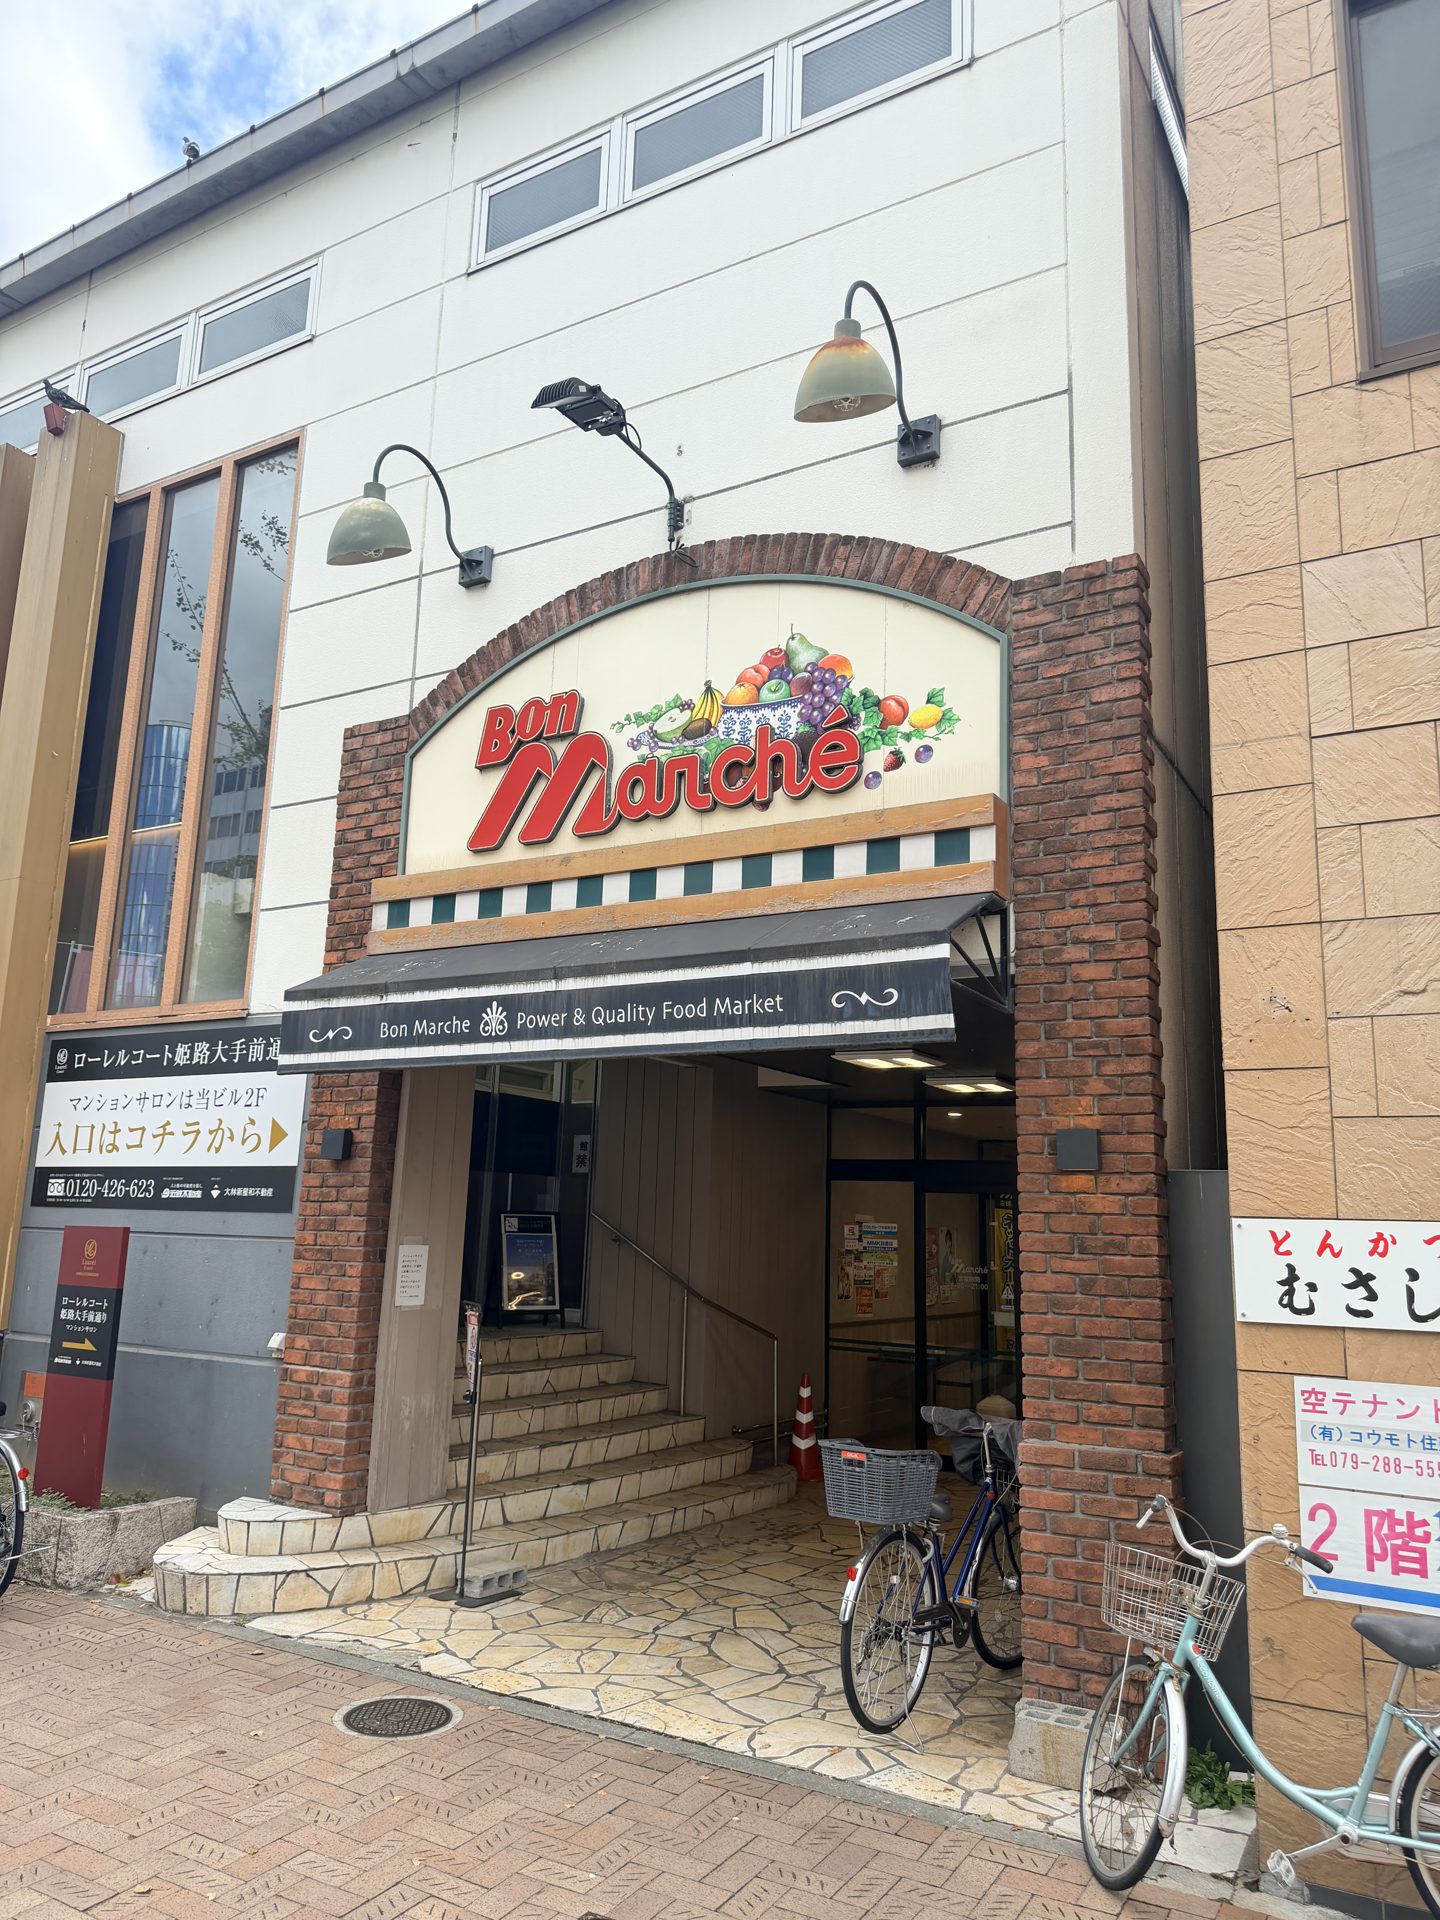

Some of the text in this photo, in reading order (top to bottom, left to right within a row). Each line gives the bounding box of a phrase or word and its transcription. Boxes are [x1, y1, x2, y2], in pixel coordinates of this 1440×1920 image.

[467, 704, 865, 853] Marché
[380, 993, 784, 1038] Bon Marche Power & Quality Food Market
[74, 1036, 280, 1069] ローレルコート姫路大手前通
[69, 1087, 268, 1112] マンションサロンは当ビル2F
[44, 1116, 262, 1156] 入口はコチラから
[66, 1178, 155, 1199] 0120-426-623
[62, 1296, 108, 1310] ローレルコート
[1276, 1262, 1440, 1324] むさし
[60, 1308, 107, 1324] 姫路大手前通り
[65, 1324, 98, 1333] マンションサロン
[1309, 1423, 1440, 1452] （有）コウモト住
[1307, 1502, 1432, 1579] 2階
